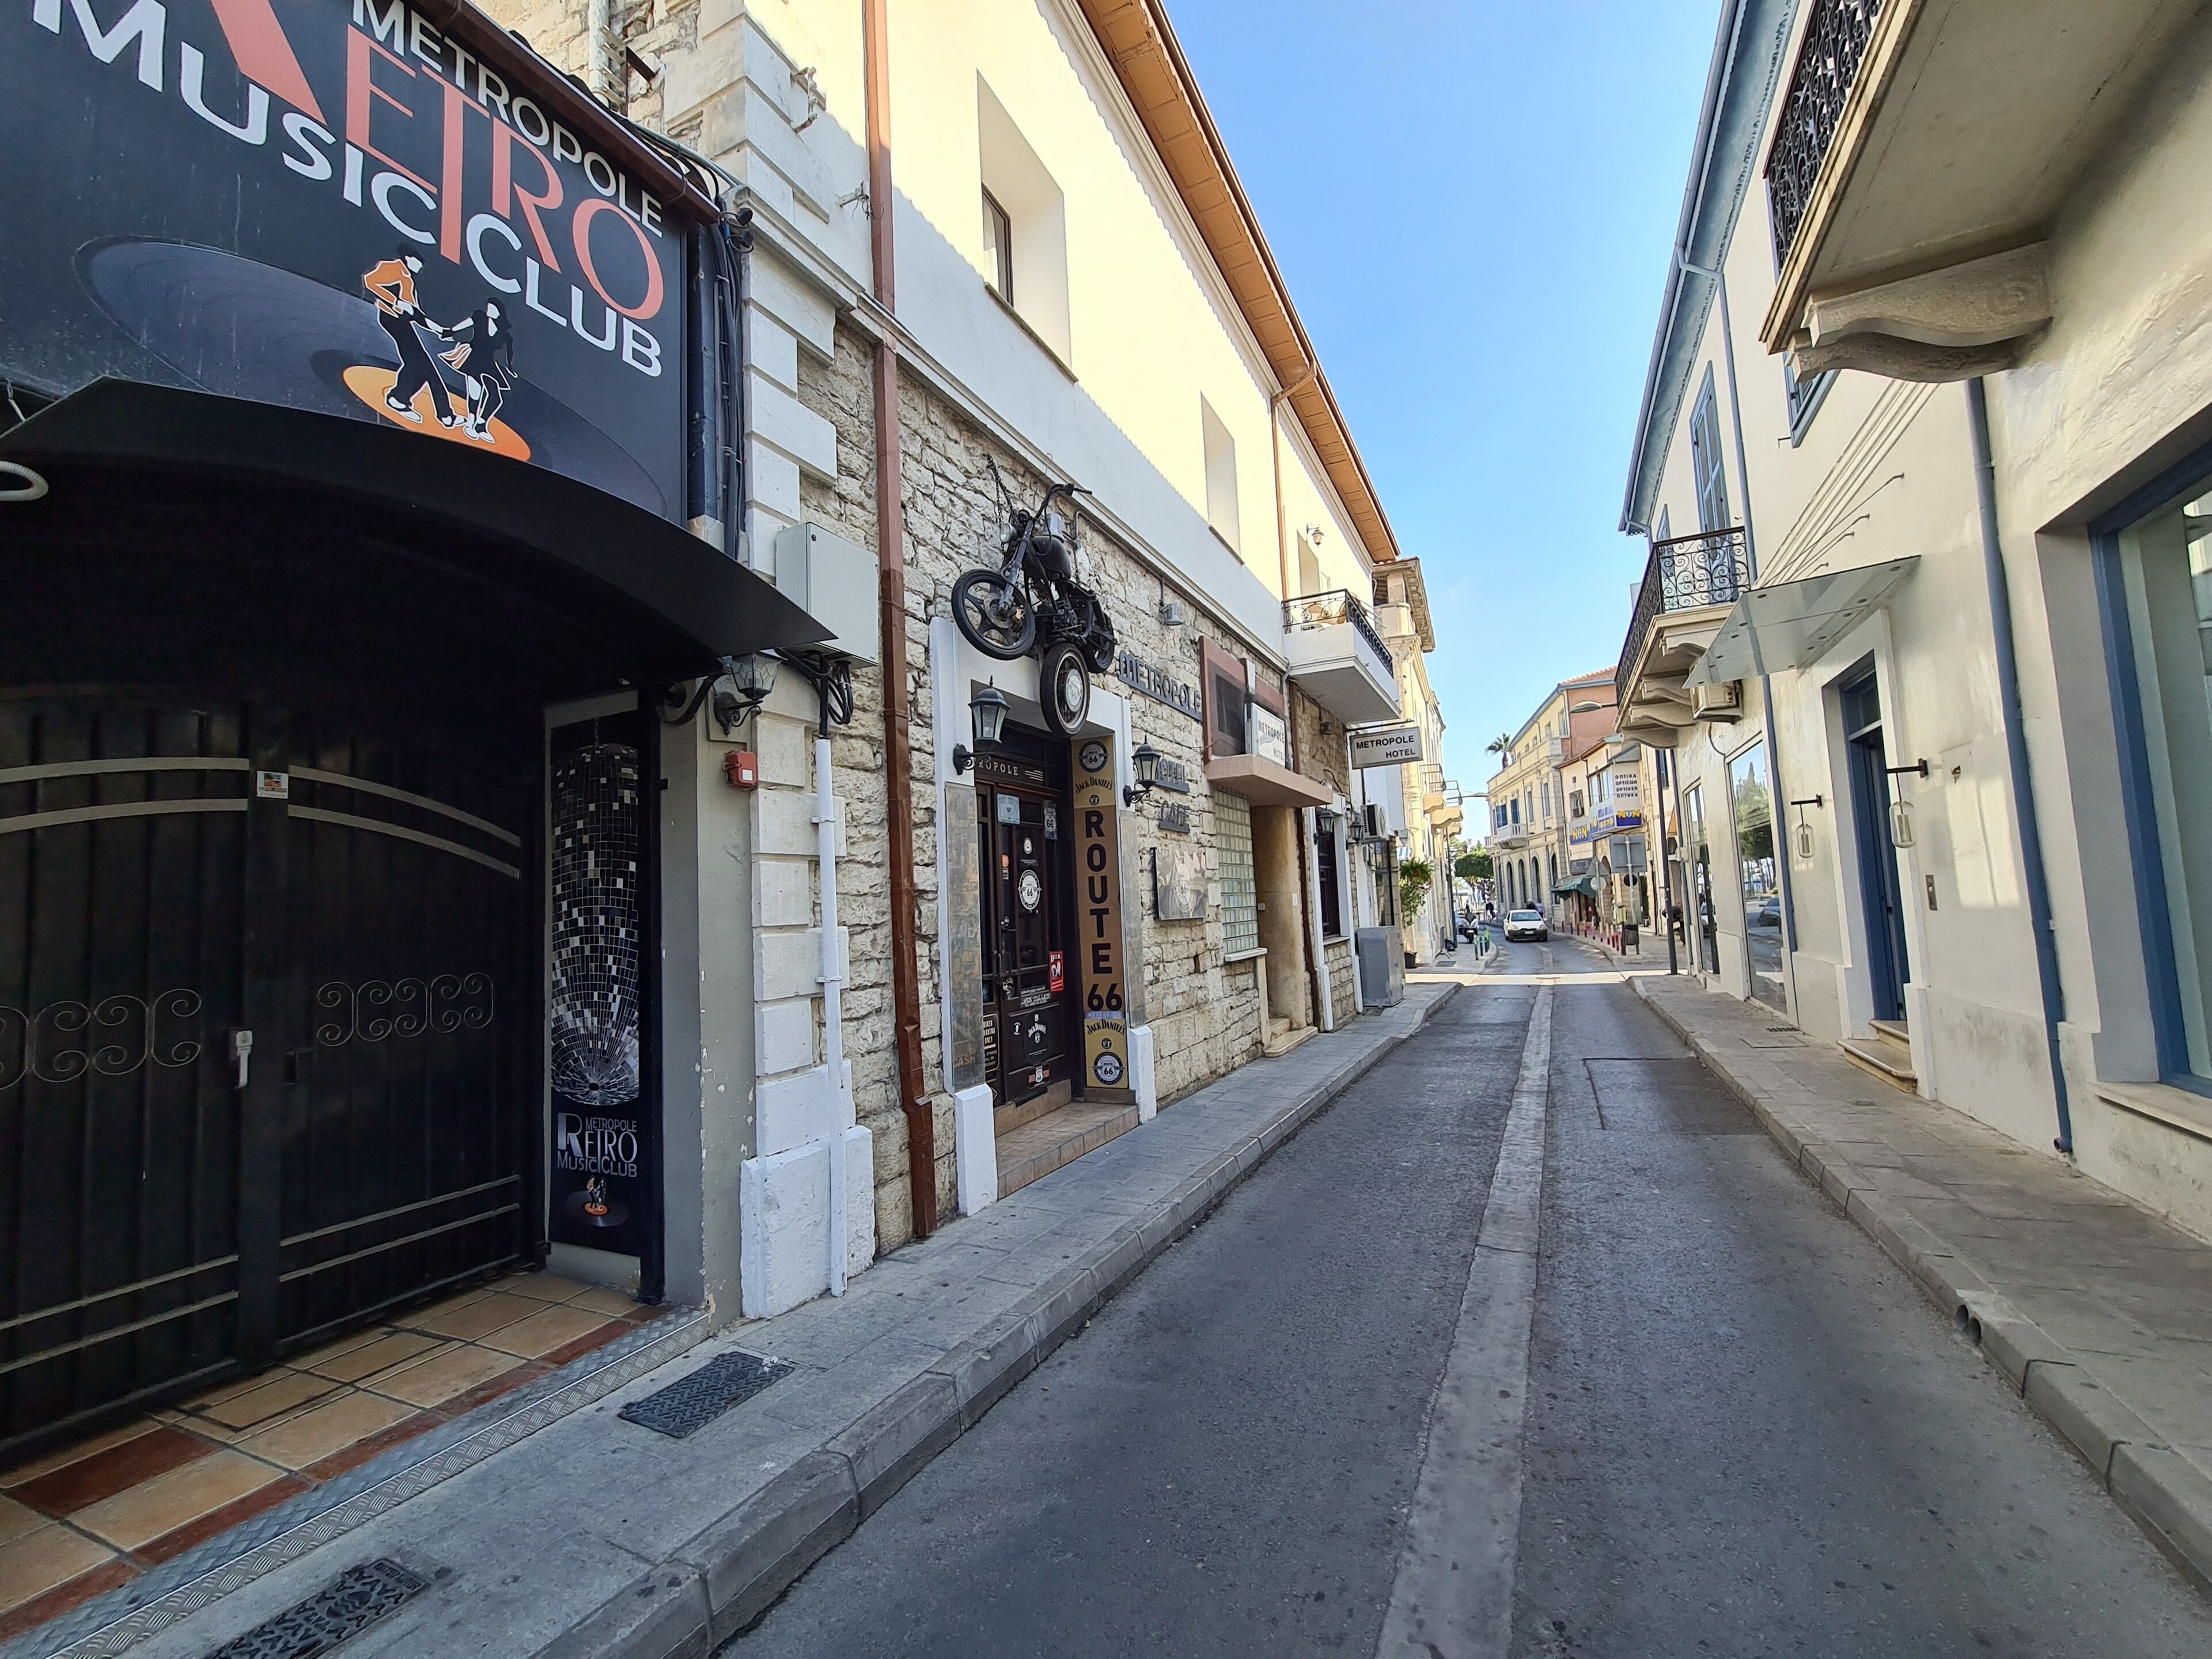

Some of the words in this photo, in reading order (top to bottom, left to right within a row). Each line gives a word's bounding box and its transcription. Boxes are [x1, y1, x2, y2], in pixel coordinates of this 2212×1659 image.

[353, 0, 664, 238] METROPOLE
[33, 0, 438, 245] MUSIC
[466, 213, 663, 378] CLUB
[1118, 649, 1203, 722] METROPOLE
[1258, 719, 1285, 744] METROPOLE
[1356, 734, 1415, 749] METROPOLE
[1089, 755, 1098, 763] 66
[1385, 748, 1416, 759] HOTEL
[978, 759, 1018, 775] ROPOLE
[1075, 780, 1090, 794] JACK
[1085, 809, 1112, 975] ROUTE
[1087, 983, 1123, 1012] 66
[1086, 1021, 1101, 1035] JACK
[1101, 1019, 1125, 1035] DANIEL'S
[585, 1116, 638, 1132] METROPOLE
[558, 1112, 638, 1173] RETRO
[557, 1150, 598, 1172] MUSIC
[601, 1155, 638, 1177] CLUB
